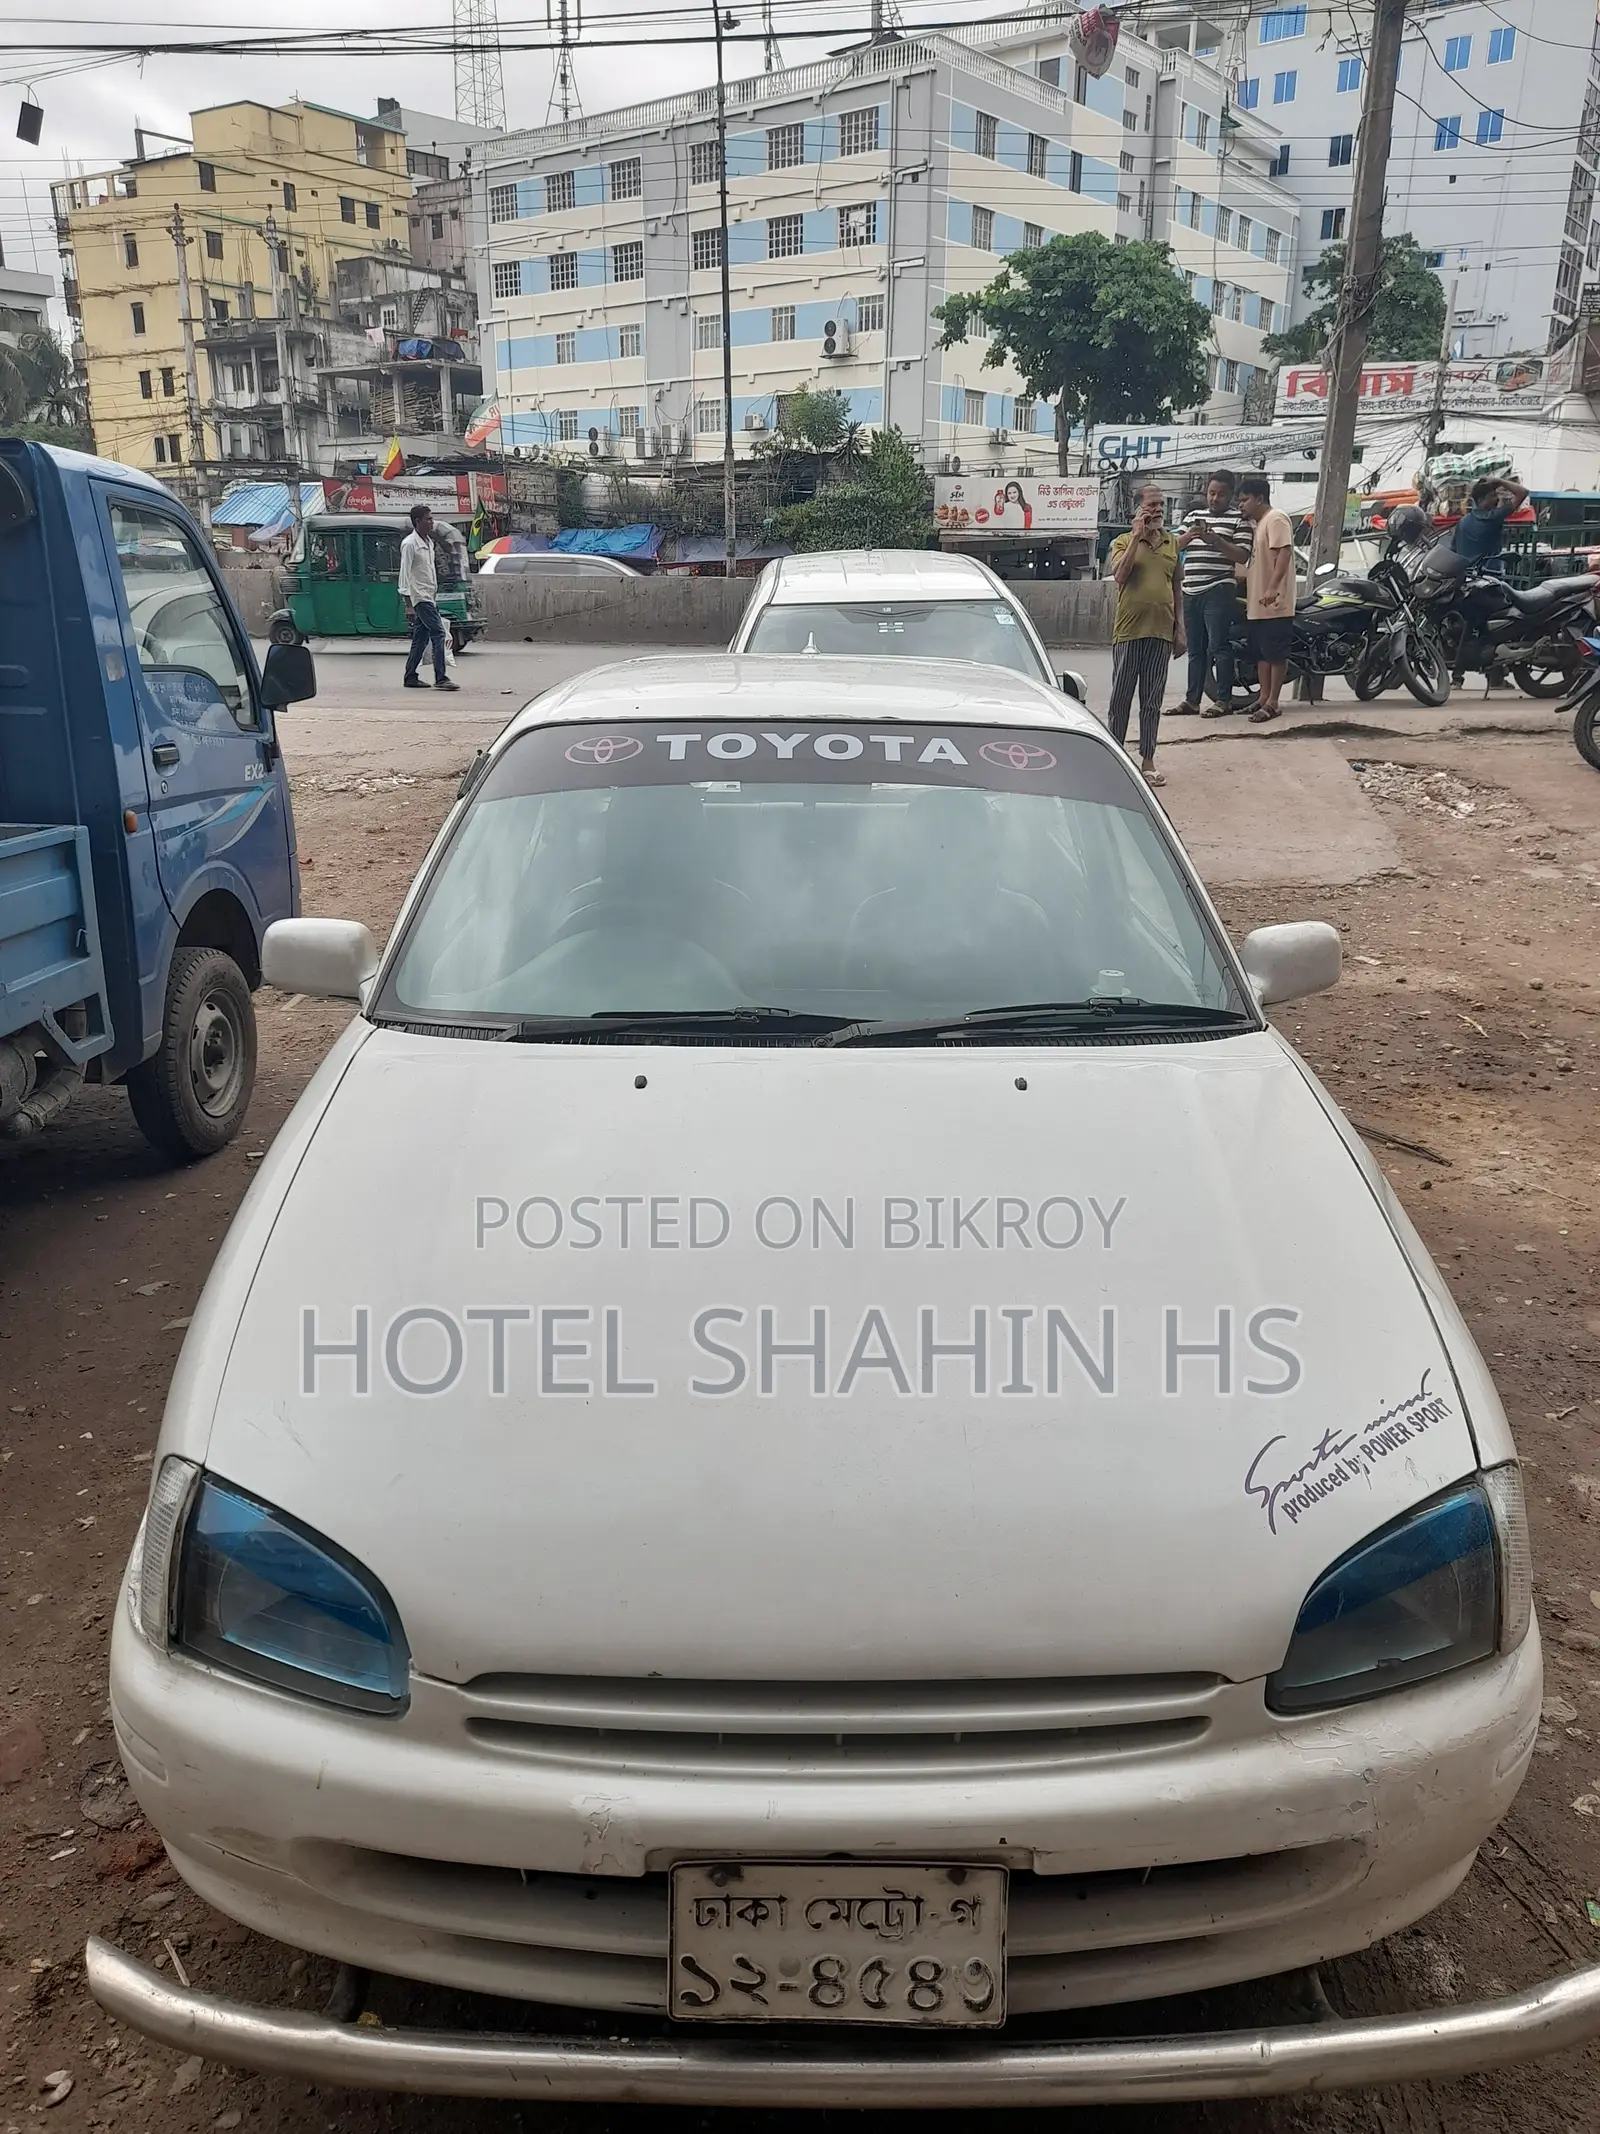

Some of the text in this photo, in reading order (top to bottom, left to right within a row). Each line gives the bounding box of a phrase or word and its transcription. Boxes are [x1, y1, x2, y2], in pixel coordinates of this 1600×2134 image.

[1099, 436, 1171, 460] GHIT
[1184, 432, 1217, 440] GOLDEN
[1219, 432, 1255, 440] HARVEST
[656, 733, 970, 766] TOYOTA
[244, 762, 265, 782] EX2
[1281, 1462, 1351, 1524] produced
[1359, 1420, 1416, 1463] POWER
[1407, 1397, 1454, 1434] SPORT
[693, 1893, 788, 1929] ঢাকা
